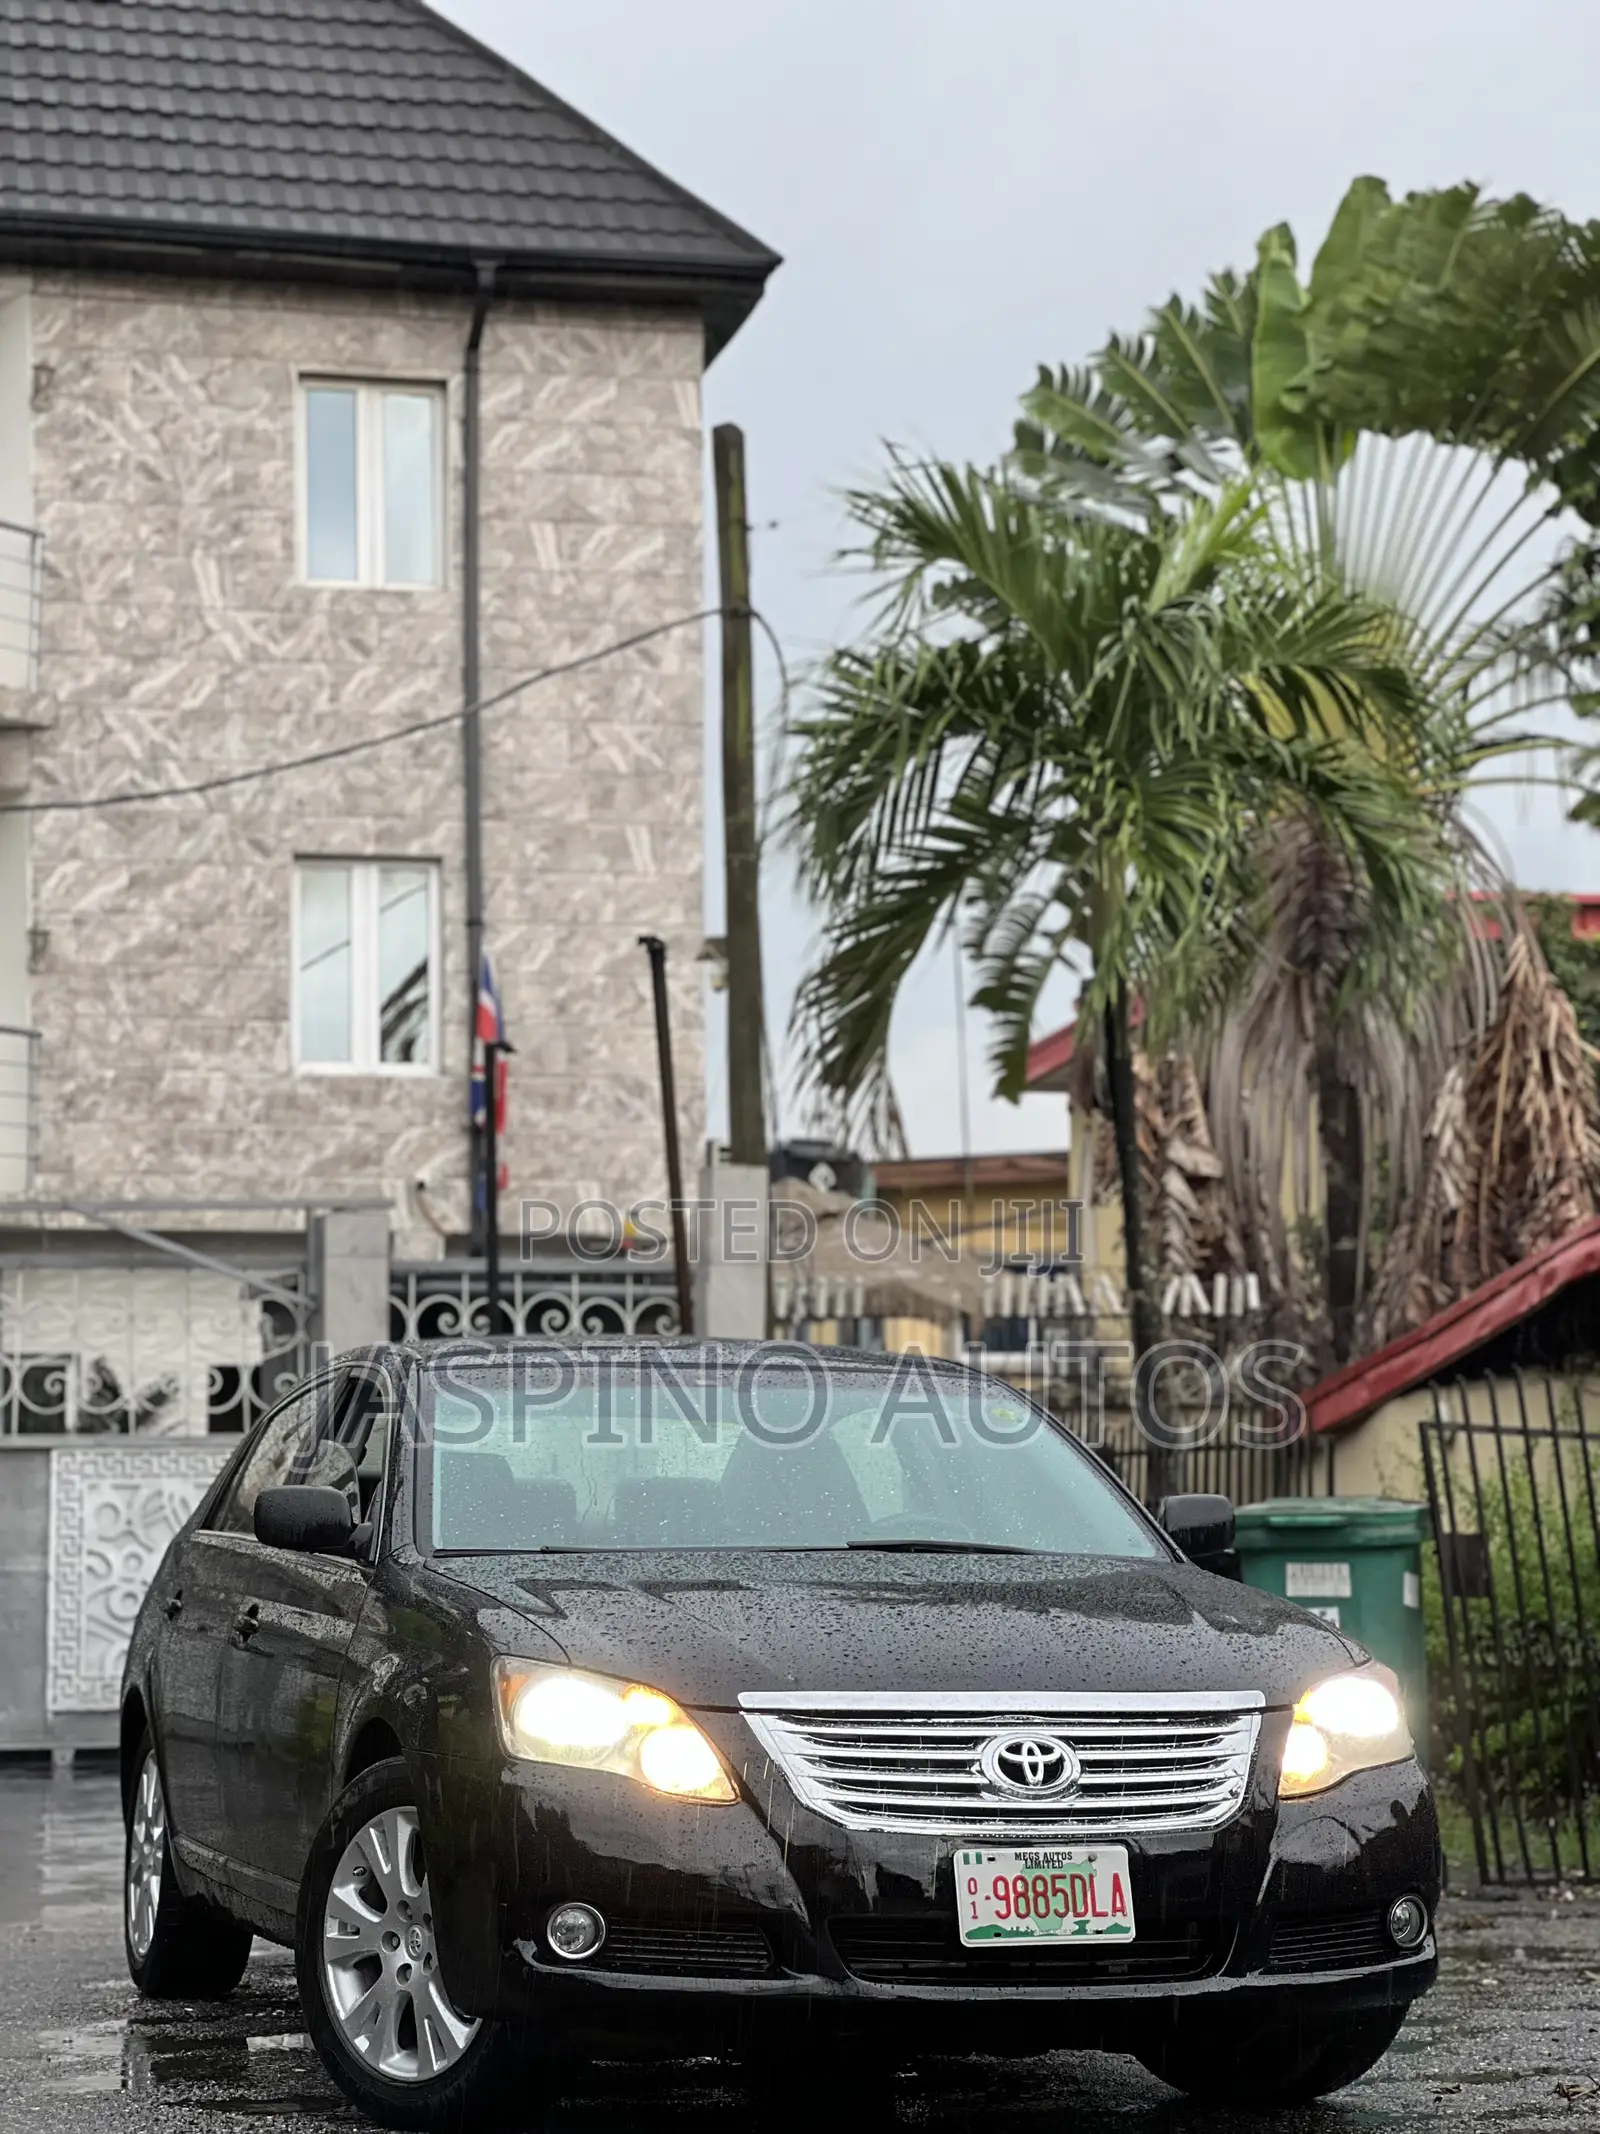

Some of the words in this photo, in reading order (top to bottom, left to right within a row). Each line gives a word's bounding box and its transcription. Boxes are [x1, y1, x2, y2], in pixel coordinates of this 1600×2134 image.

[1014, 1851, 1040, 1861] MEGS
[1043, 1851, 1073, 1861] AUTOS
[1024, 1860, 1064, 1870] LIMITED
